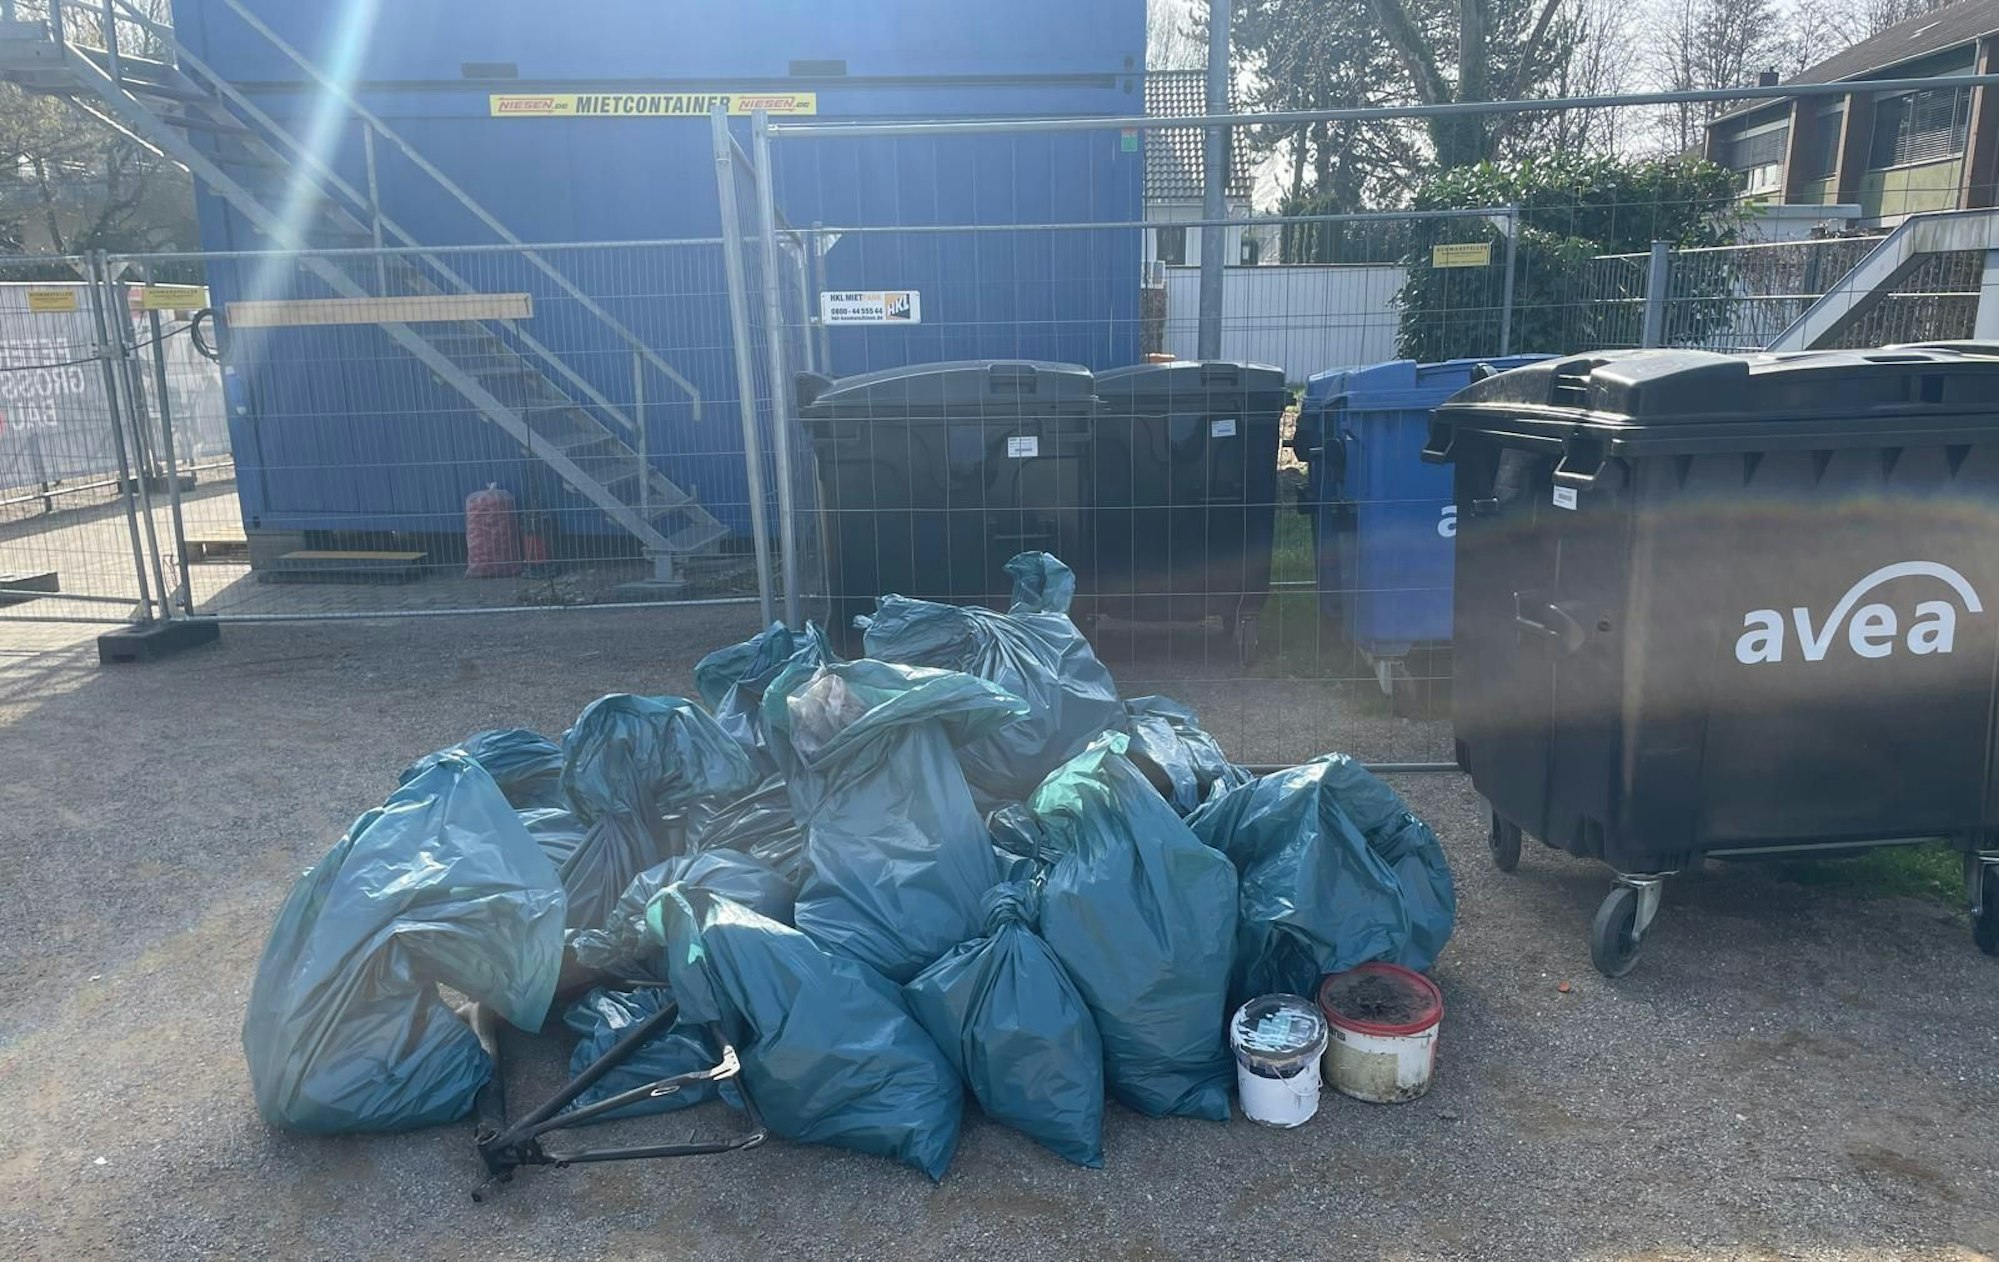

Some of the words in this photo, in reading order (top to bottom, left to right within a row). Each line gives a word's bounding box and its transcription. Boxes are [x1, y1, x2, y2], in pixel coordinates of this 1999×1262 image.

[576, 95, 731, 113] MIETCONTAINER
[887, 297, 909, 315] HKL
[1735, 561, 1983, 664] avea
